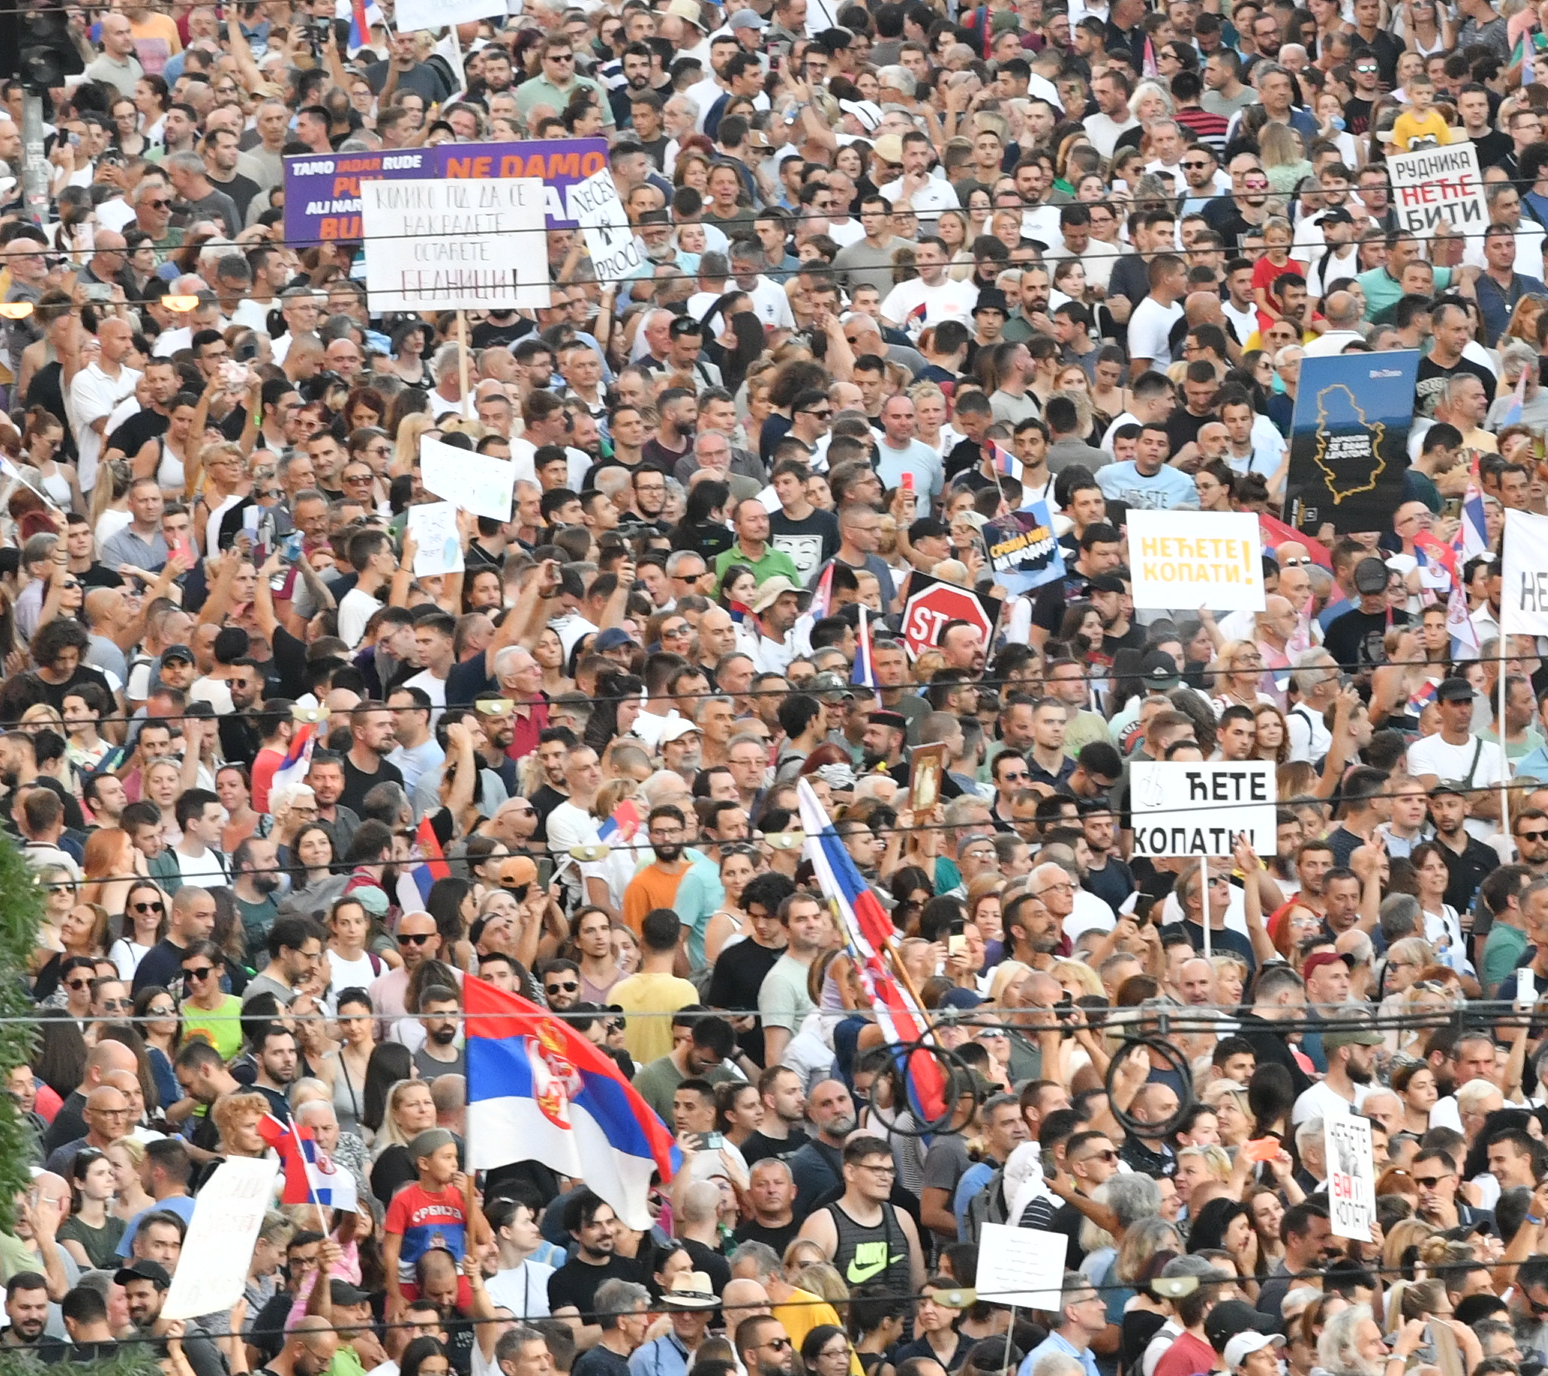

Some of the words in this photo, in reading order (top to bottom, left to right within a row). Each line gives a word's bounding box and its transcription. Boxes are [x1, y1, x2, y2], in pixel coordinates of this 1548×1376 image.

[292, 161, 334, 177] TAMO
[383, 155, 422, 171] RUDE
[446, 156, 489, 179] NE
[500, 150, 605, 181] DAMO
[1396, 151, 1471, 181] РУДНИКА
[1400, 174, 1476, 207] НЕЋЕ
[1405, 199, 1482, 233] БИТИ
[1141, 535, 1239, 561] НЕЋЕТЕ
[1185, 772, 1268, 802] ЋЕТЕ
[411, 1204, 463, 1224] СРБИЈА
